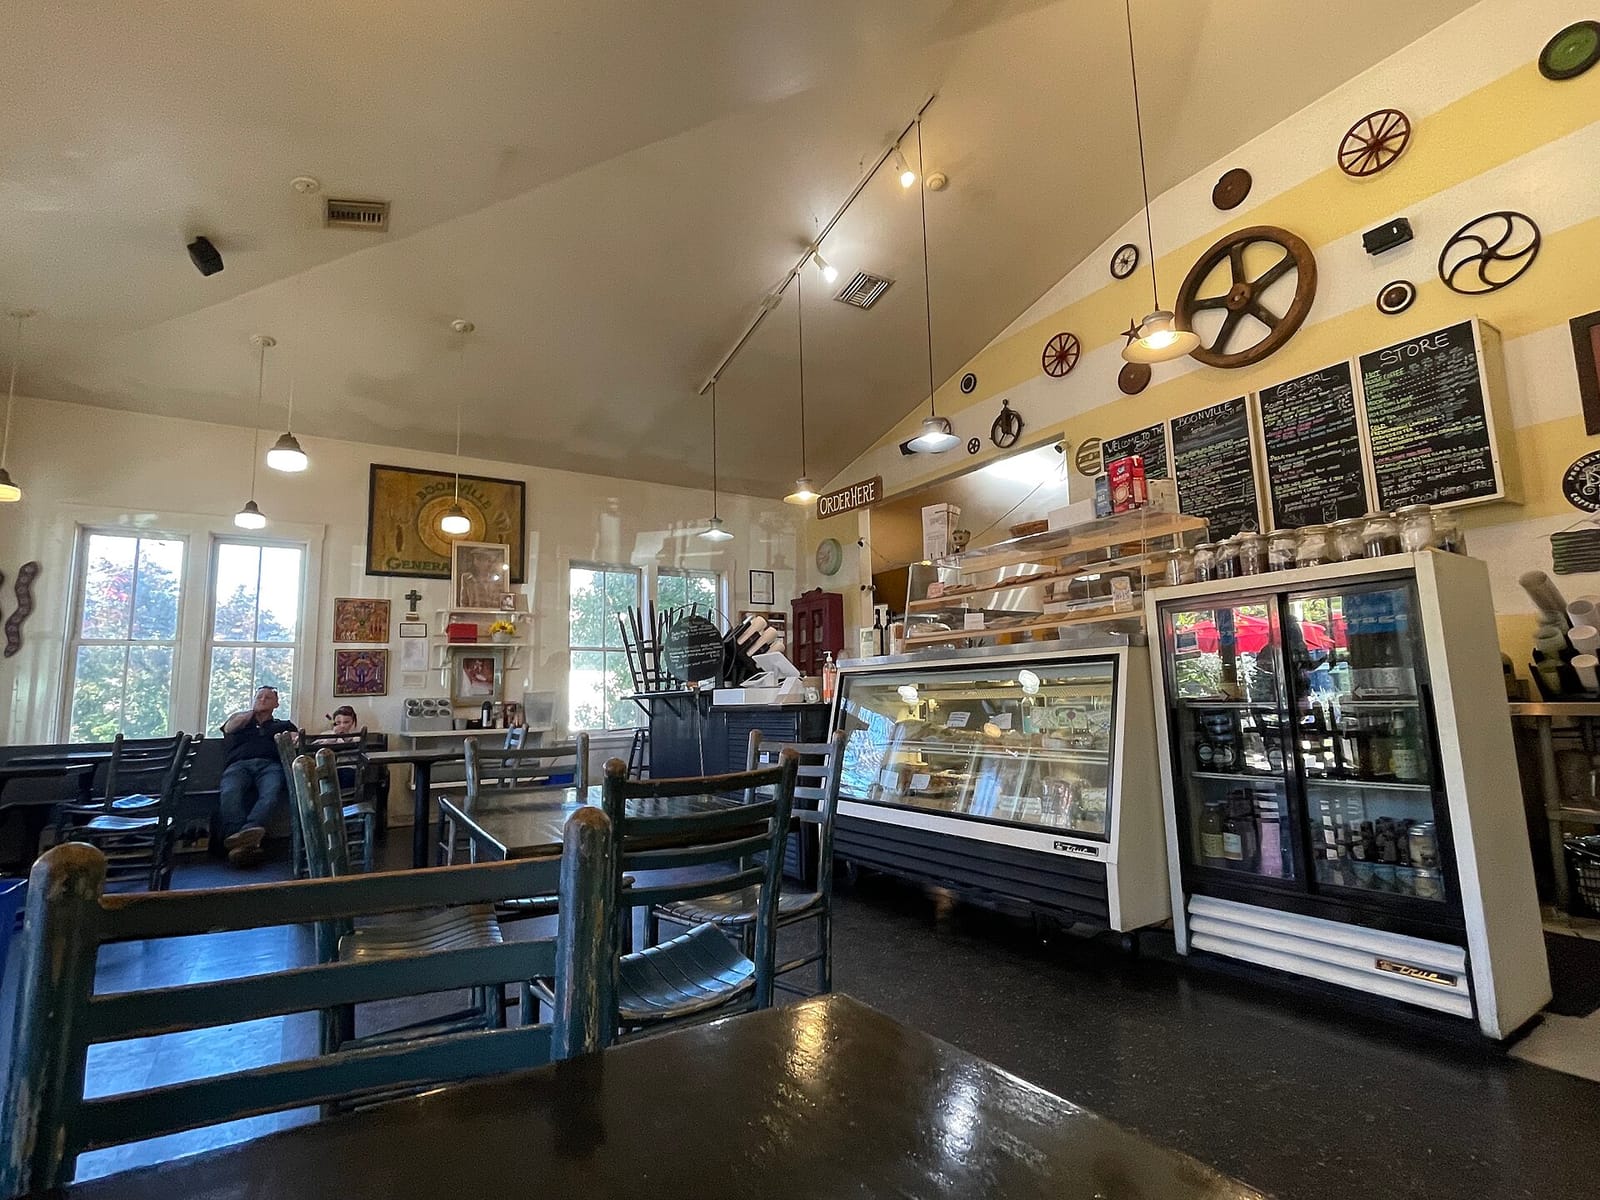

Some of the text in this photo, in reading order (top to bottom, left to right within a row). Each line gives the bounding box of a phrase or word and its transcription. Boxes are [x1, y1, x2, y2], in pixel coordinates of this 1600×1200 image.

[1379, 333, 1450, 367] STORE
[1276, 373, 1331, 397] GENERAL
[1176, 402, 1232, 430] BOONVILLE
[1105, 435, 1141, 453] WELCOME
[1141, 431, 1151, 440] TO
[416, 482, 493, 510] BOONVILLE
[820, 482, 875, 515] ORDER HERE
[386, 556, 451, 572] GENERA
